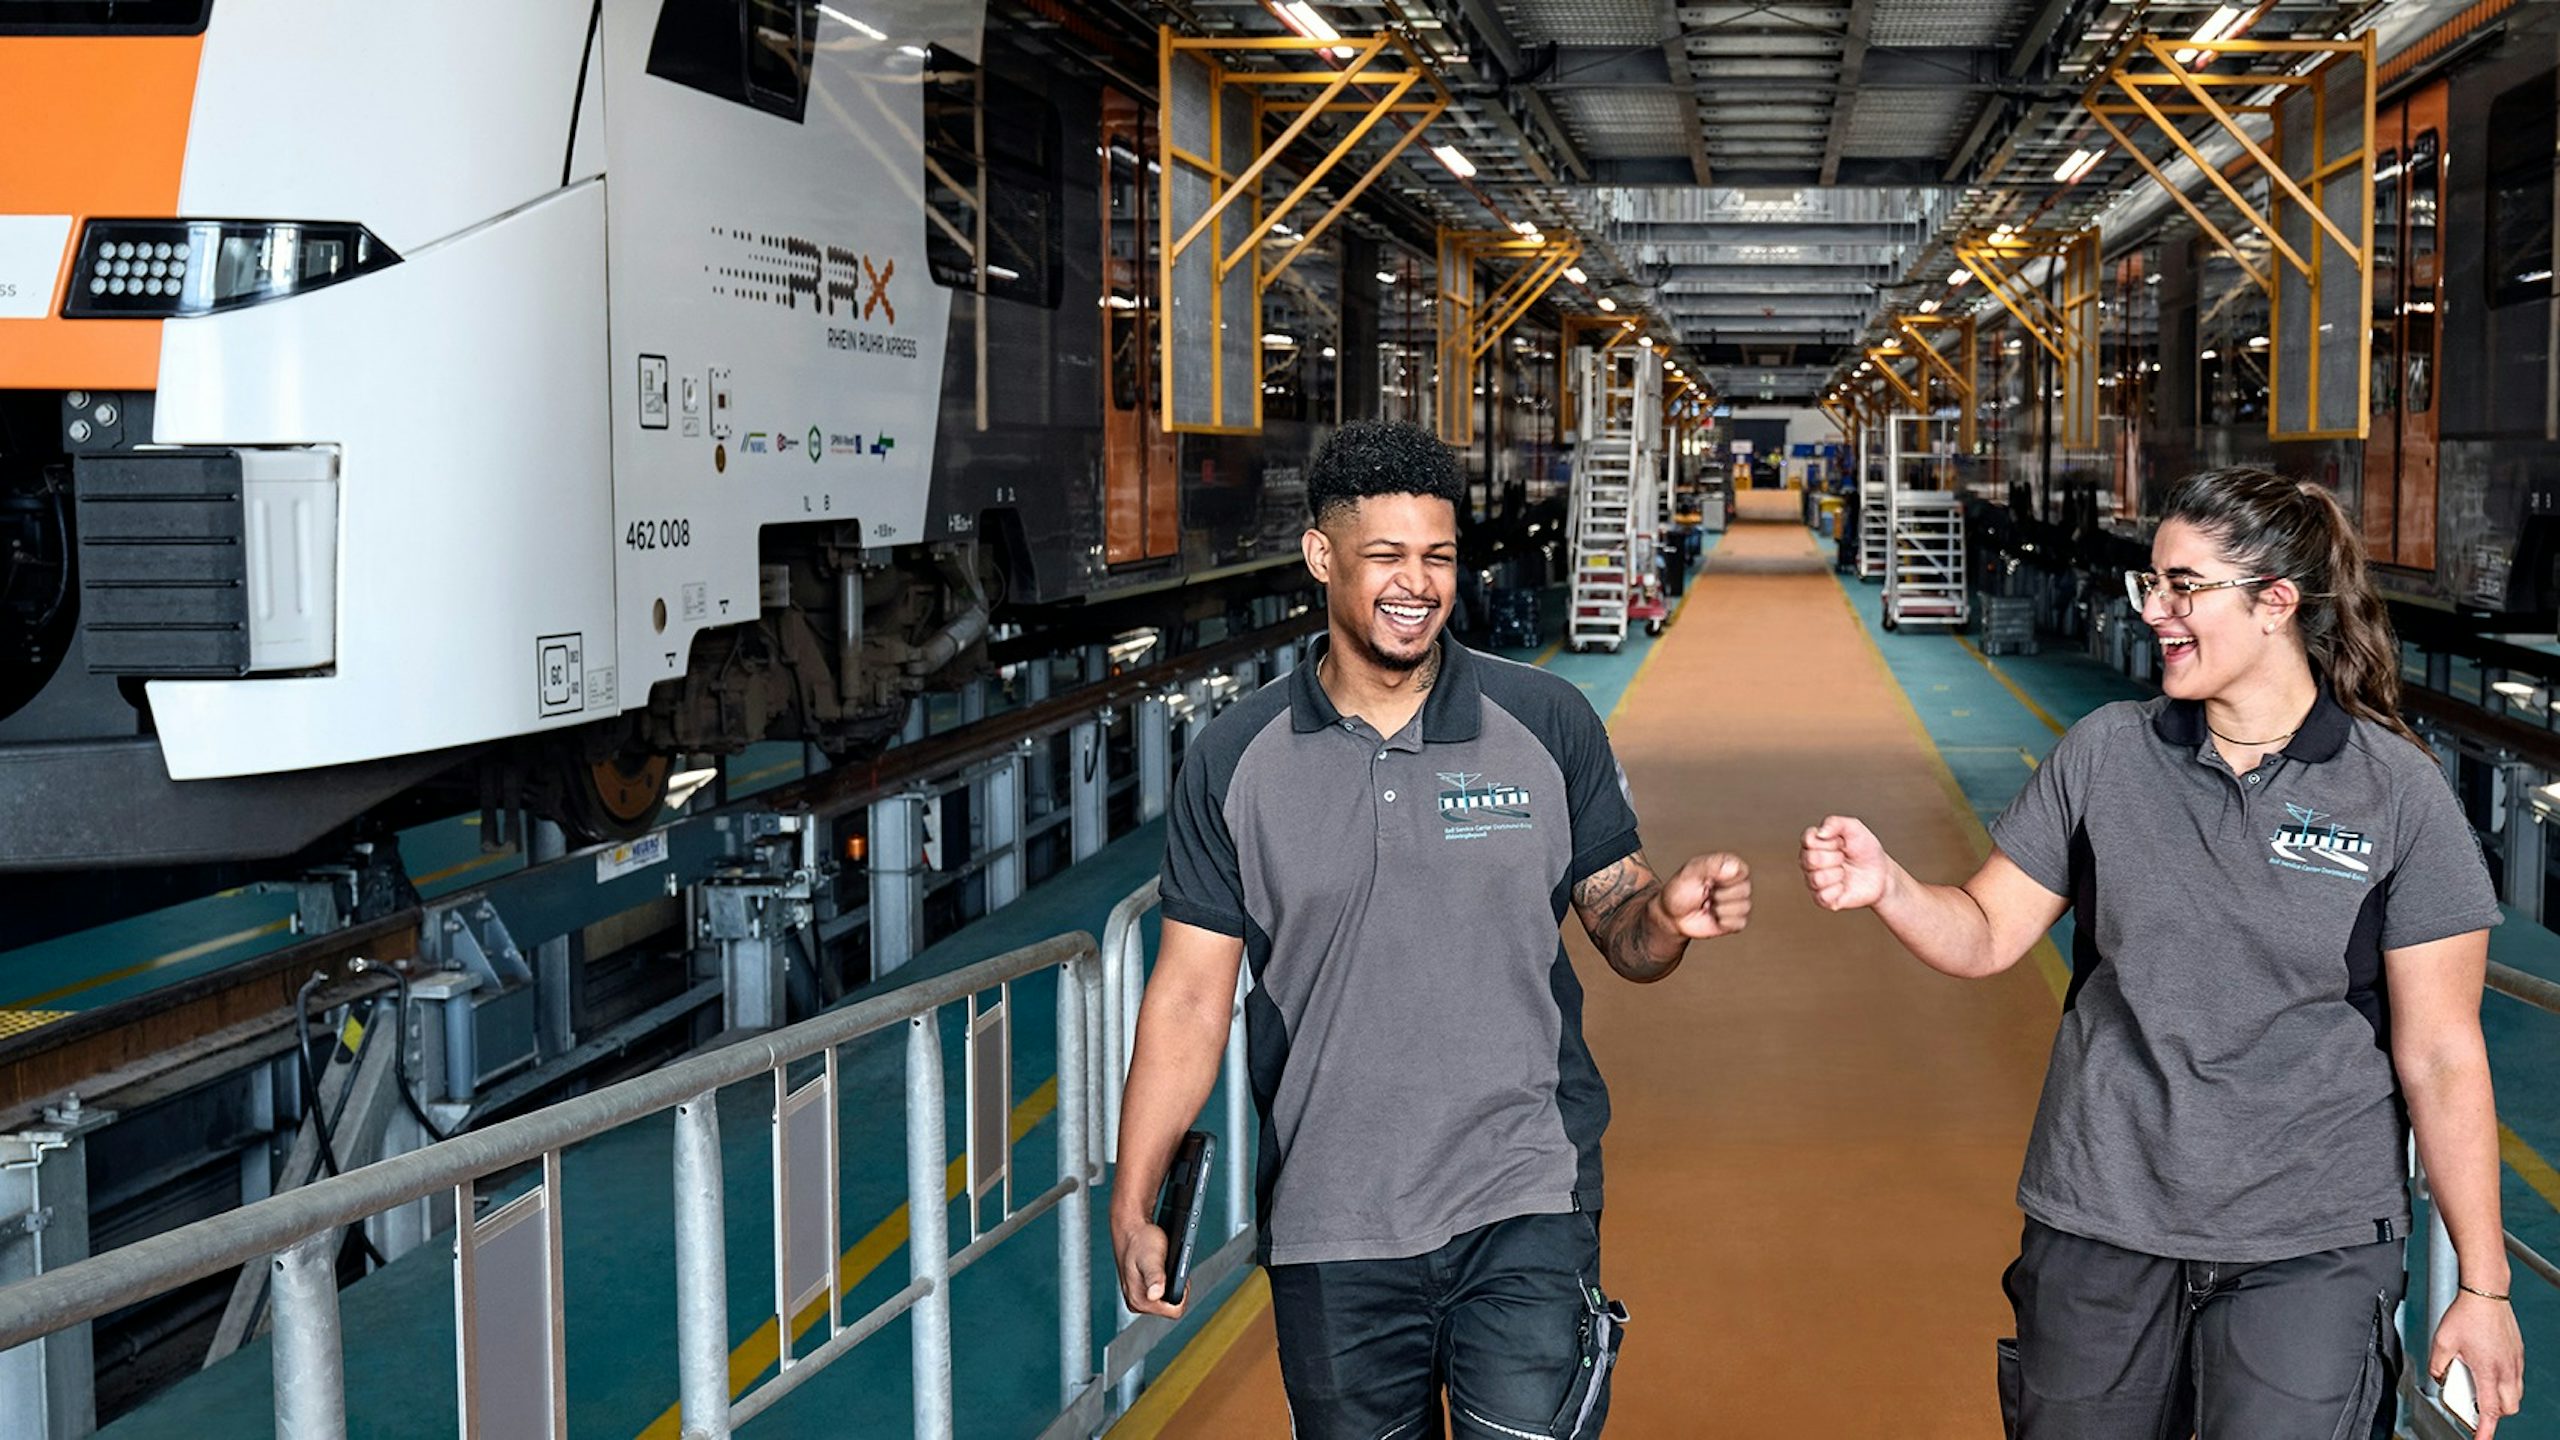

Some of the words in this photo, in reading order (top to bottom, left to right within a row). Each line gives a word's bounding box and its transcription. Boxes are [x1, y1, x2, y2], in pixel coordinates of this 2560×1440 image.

[787, 236, 895, 325] RRX
[827, 327, 857, 350] RHEIN
[859, 332, 884, 354] RUHR
[886, 336, 917, 359] XPRESS
[626, 520, 655, 550] 462
[660, 519, 690, 548] 008
[1456, 825, 1474, 833] Service
